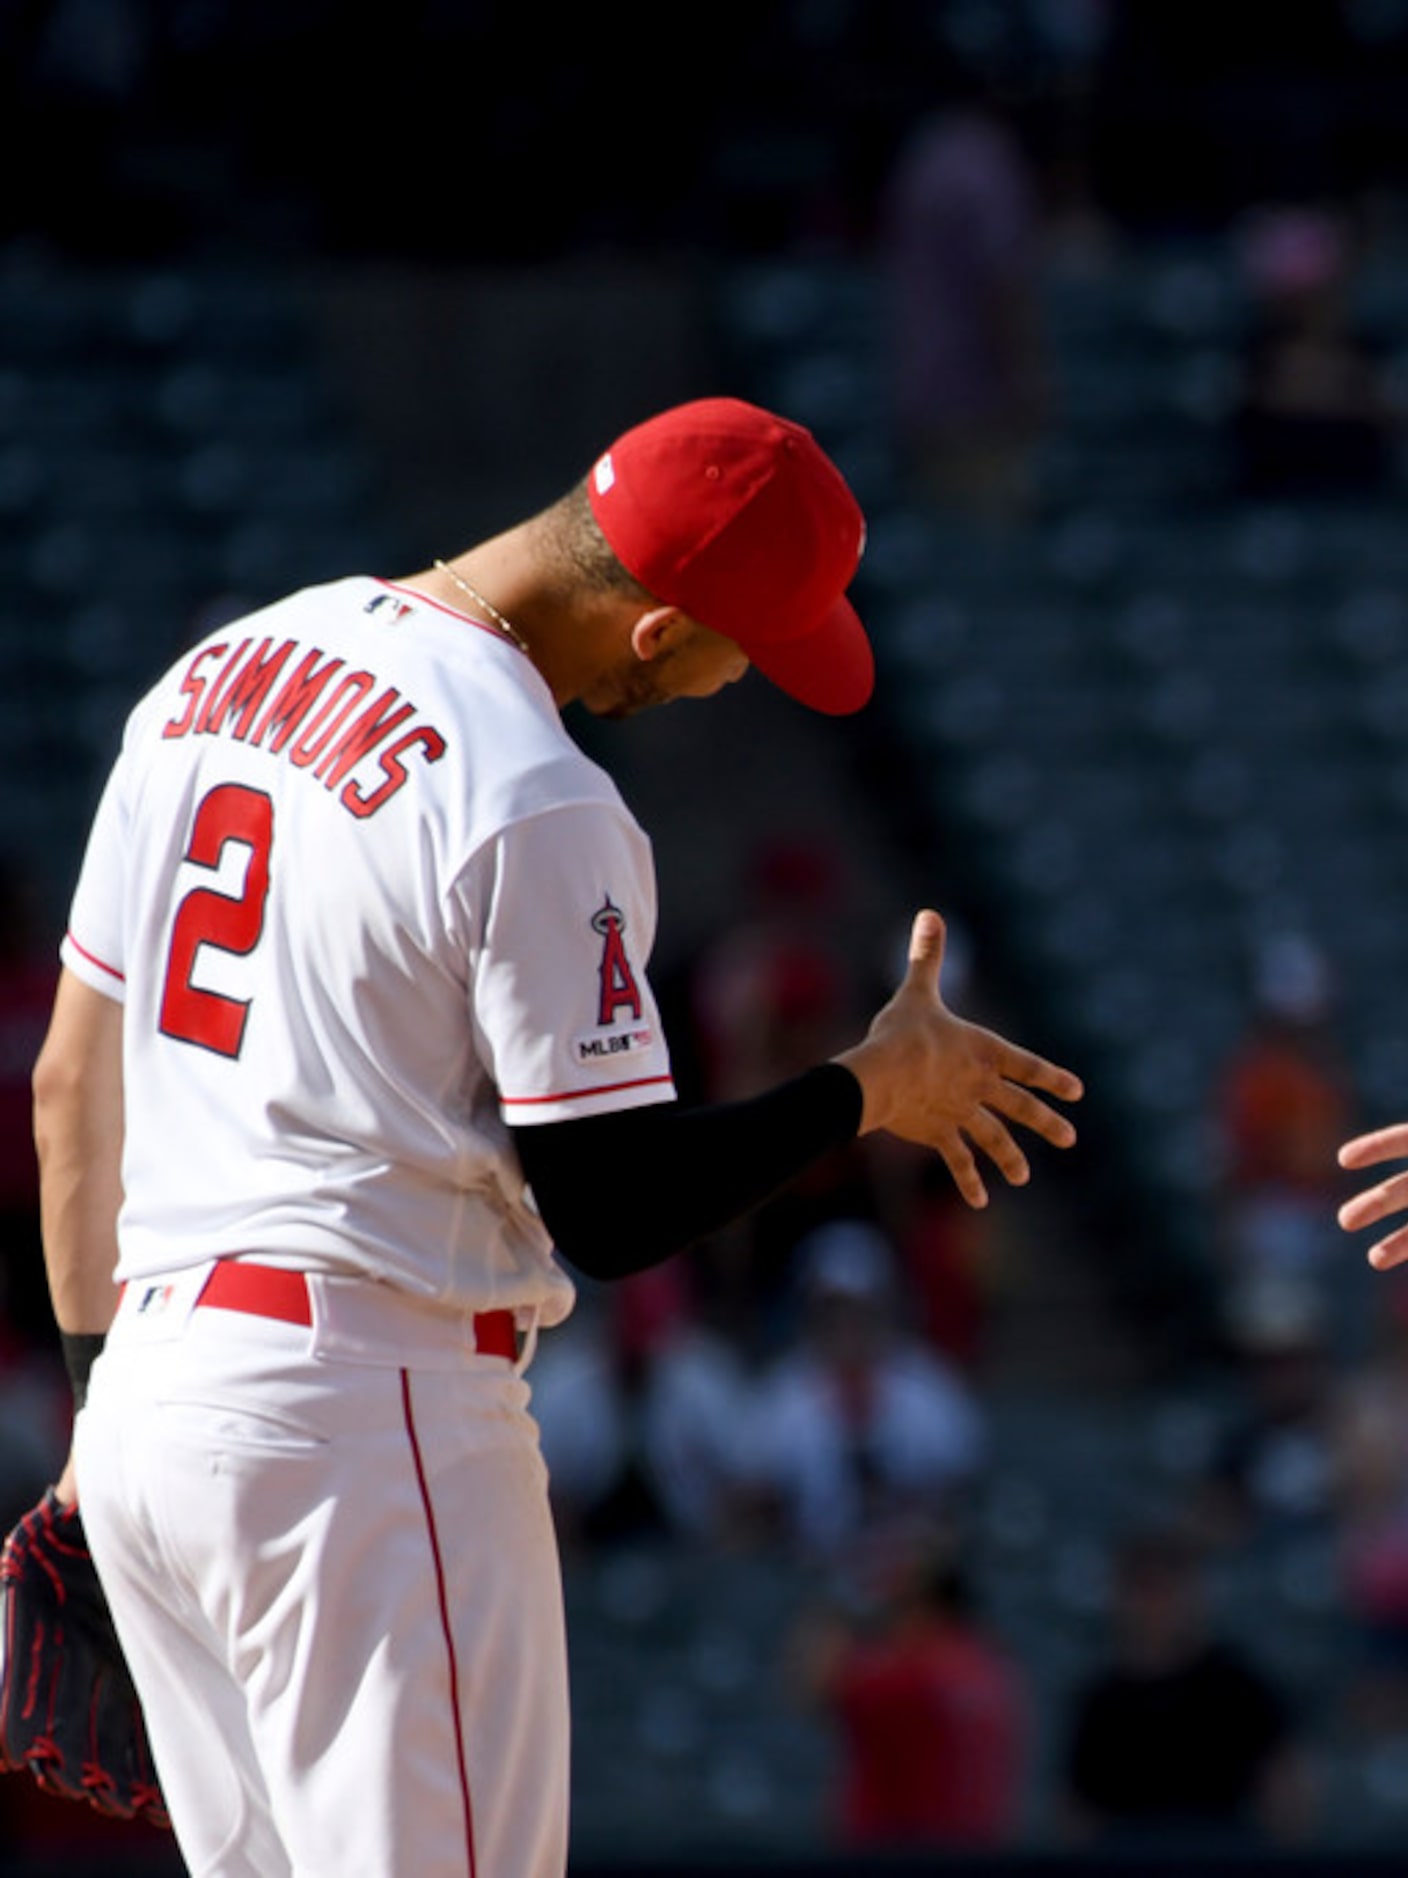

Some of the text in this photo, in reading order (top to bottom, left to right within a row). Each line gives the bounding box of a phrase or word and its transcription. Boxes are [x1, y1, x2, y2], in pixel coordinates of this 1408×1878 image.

[161, 637, 447, 819] SIMMONS
[158, 782, 274, 1061] 2
[591, 891, 642, 1025] A
